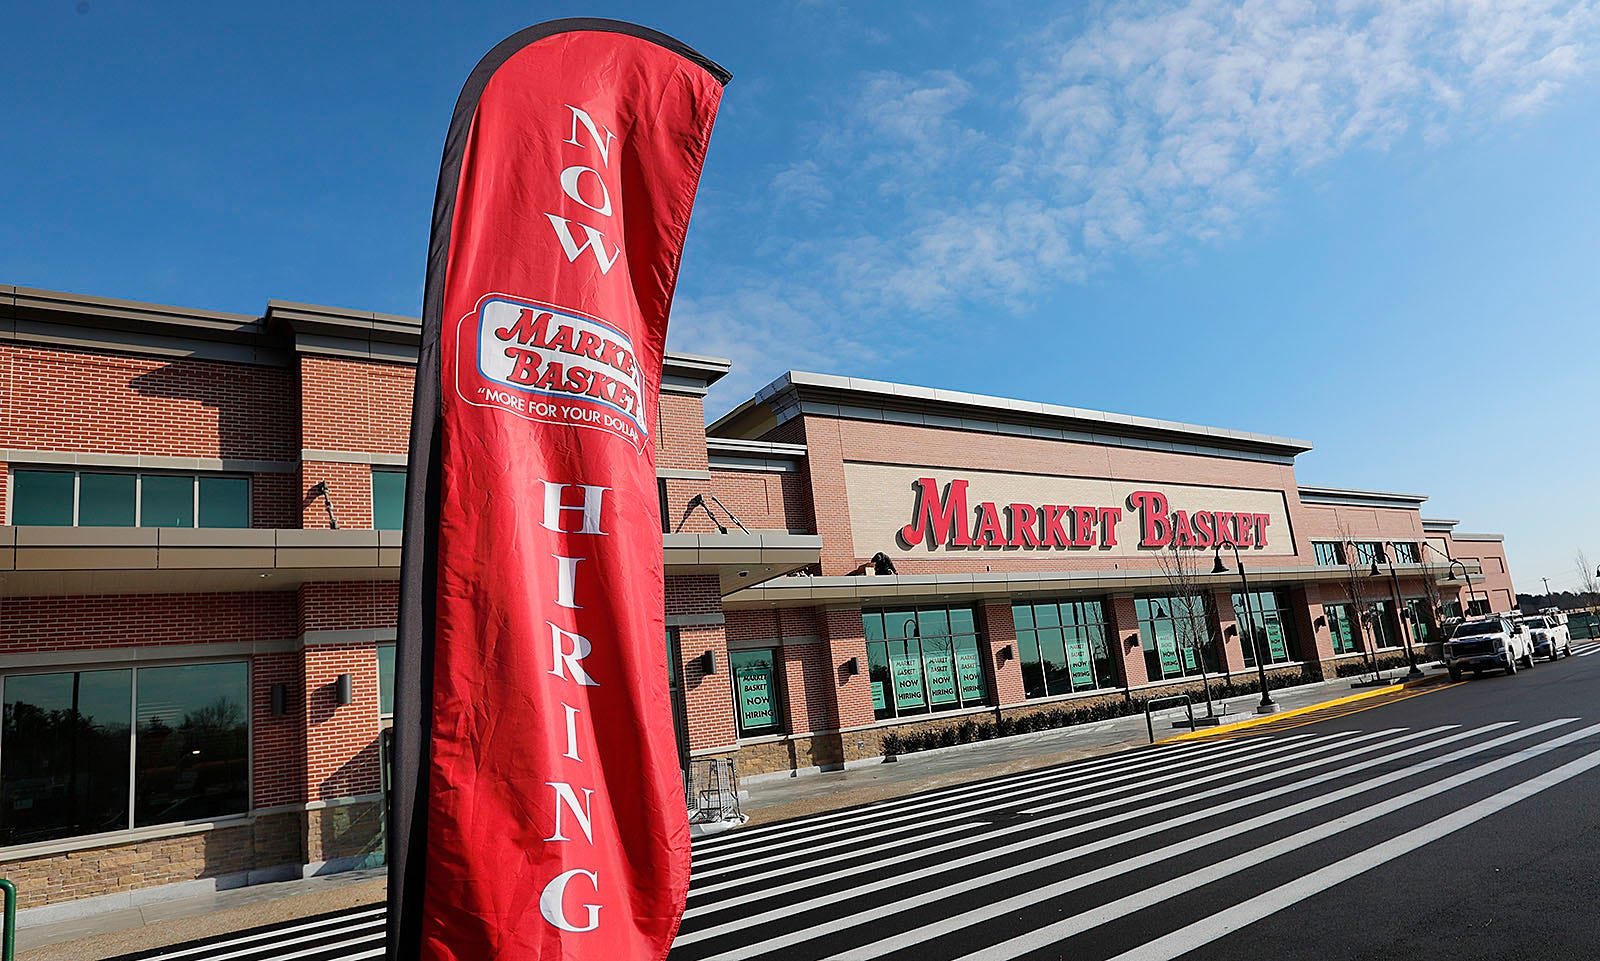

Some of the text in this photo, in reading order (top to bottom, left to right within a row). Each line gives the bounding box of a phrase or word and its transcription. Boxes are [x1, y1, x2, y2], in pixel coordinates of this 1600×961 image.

[544, 103, 621, 275] NOW
[494, 308, 638, 385] MARKE
[505, 347, 638, 418] BASKET
[528, 402, 557, 418] FOR
[561, 406, 601, 424] YOUR
[896, 477, 1271, 551] MARKET BASKET
[742, 673, 768, 682] MARKET
[932, 676, 951, 685] NOW
[963, 672, 981, 681] NOW
[744, 683, 769, 692] BASKET
[899, 679, 919, 688] NOW
[962, 684, 984, 693] HIRING
[897, 691, 922, 700] HIRING
[931, 687, 954, 697] HIRING
[538, 477, 614, 933] HIRING
[746, 696, 771, 706] NOW
[744, 710, 774, 720] HIRING
